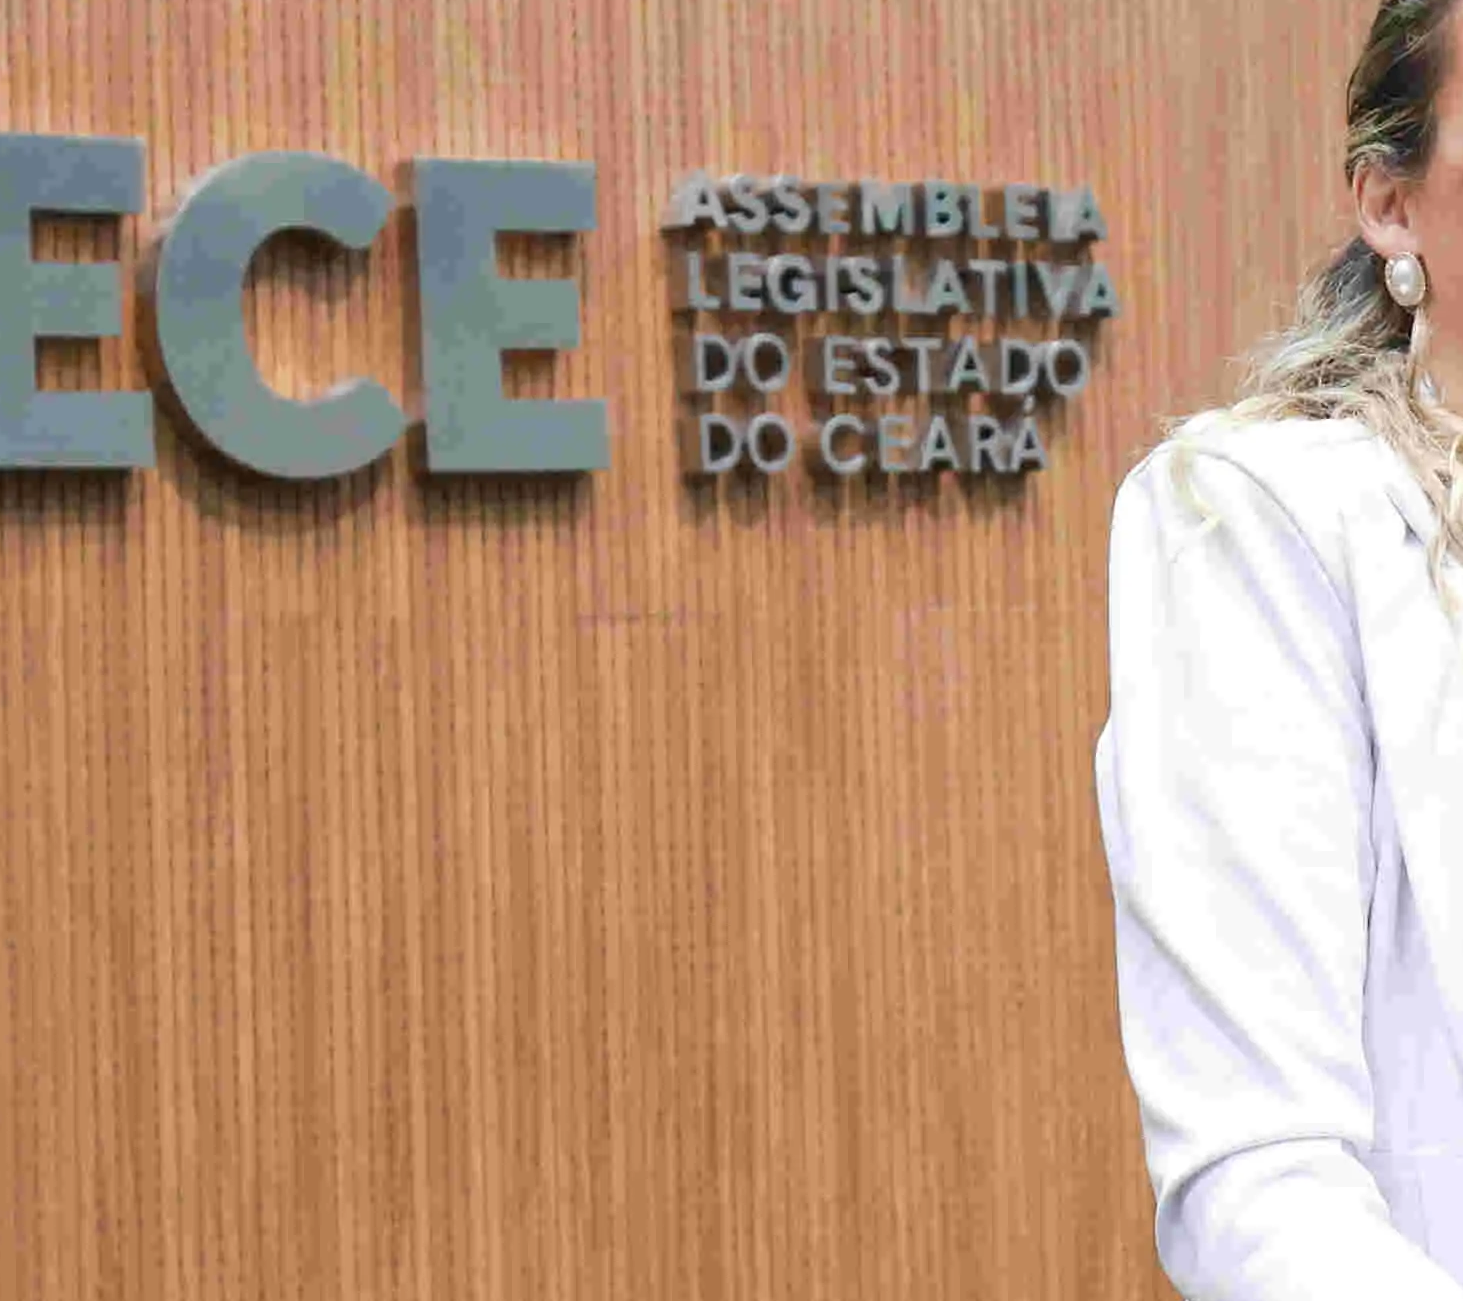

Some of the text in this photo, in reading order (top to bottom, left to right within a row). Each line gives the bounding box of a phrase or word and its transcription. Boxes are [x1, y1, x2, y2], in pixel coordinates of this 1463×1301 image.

[664, 170, 1108, 242] ASSEMBLEIA
[685, 250, 1122, 317] LEGISLATIVA
[693, 333, 1090, 396] DO ESTADO
[699, 394, 1048, 475] DO CEARÁ
